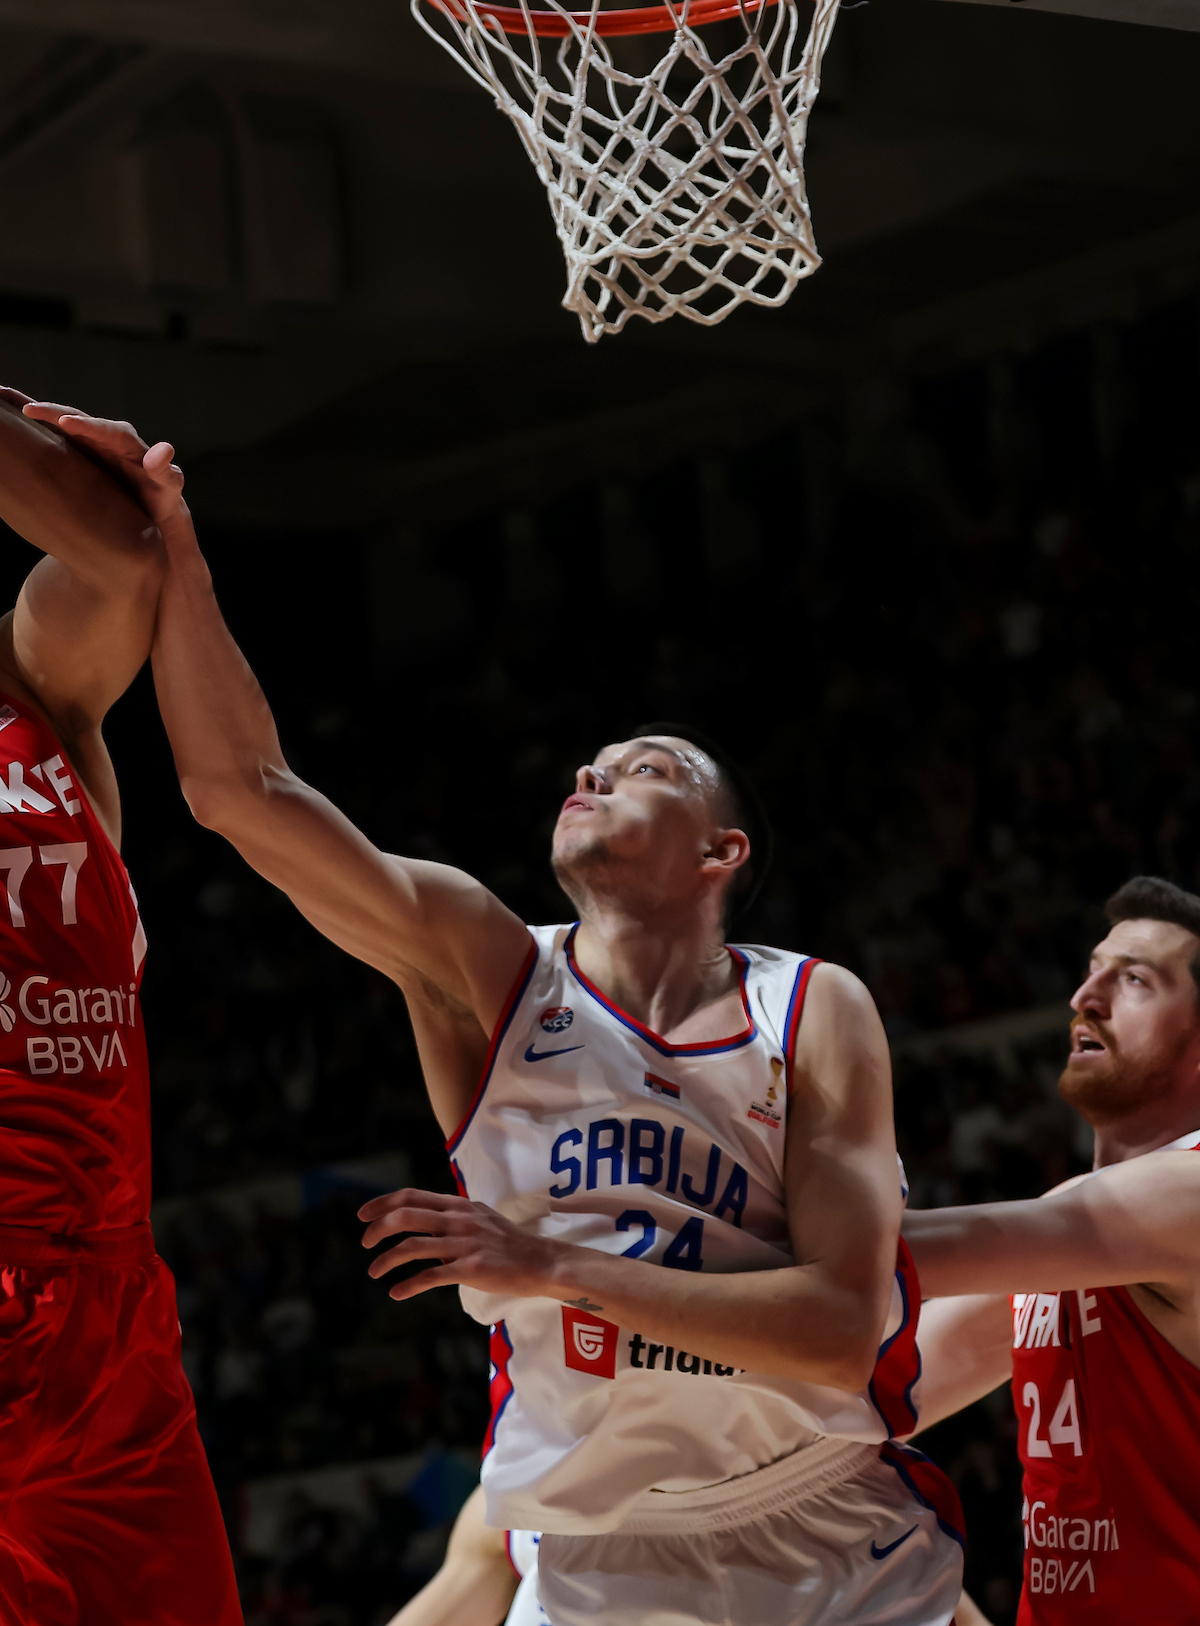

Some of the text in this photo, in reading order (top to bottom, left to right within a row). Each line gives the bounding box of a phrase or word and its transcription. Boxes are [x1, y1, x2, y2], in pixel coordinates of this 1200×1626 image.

[26, 1029, 128, 1075] BBVA
[550, 1118, 748, 1229] SRBIJA
[616, 1210, 704, 1272] 24
[1022, 1378, 1084, 1459] 24
[1030, 1500, 1120, 1551] Garani
[1030, 1557, 1096, 1595] BBVA
